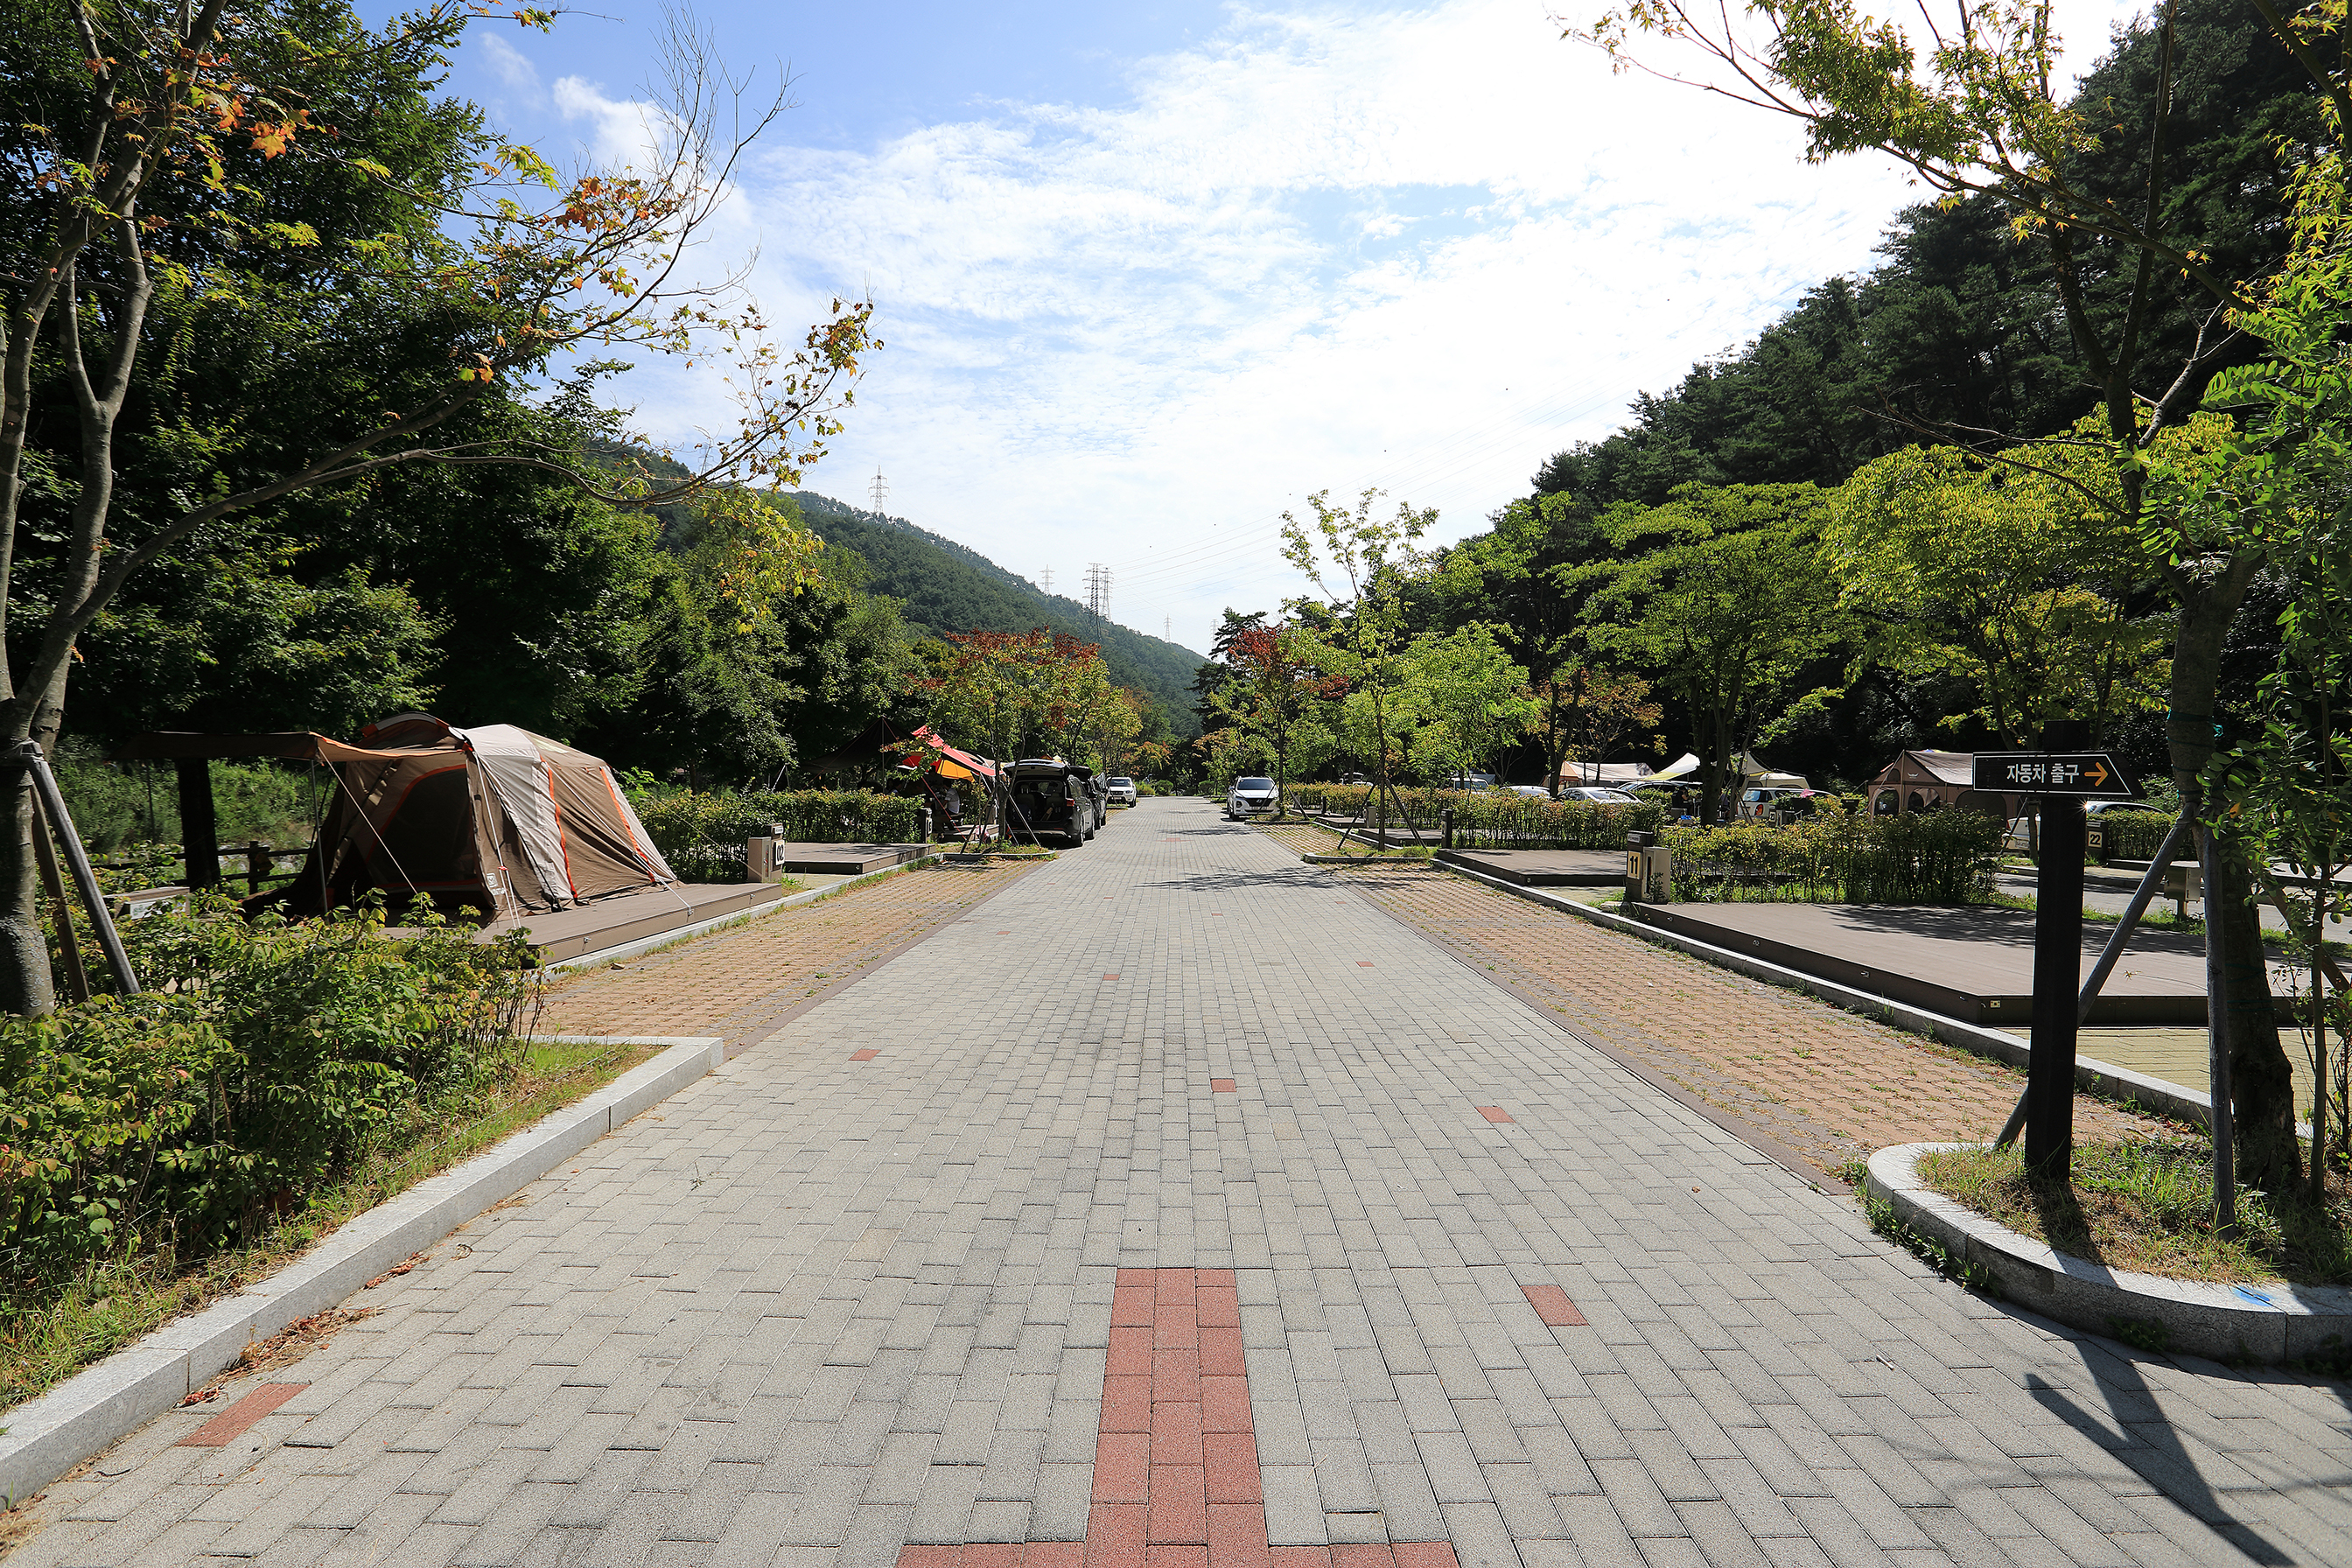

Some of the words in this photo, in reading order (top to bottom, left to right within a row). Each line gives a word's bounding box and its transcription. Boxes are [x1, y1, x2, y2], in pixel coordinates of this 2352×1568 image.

[2006, 763, 2047, 784] 자동차
[2050, 762, 2080, 784] 출구
[2090, 833, 2101, 845] 22
[776, 844, 784, 862] 02
[1629, 855, 1639, 875] 11
